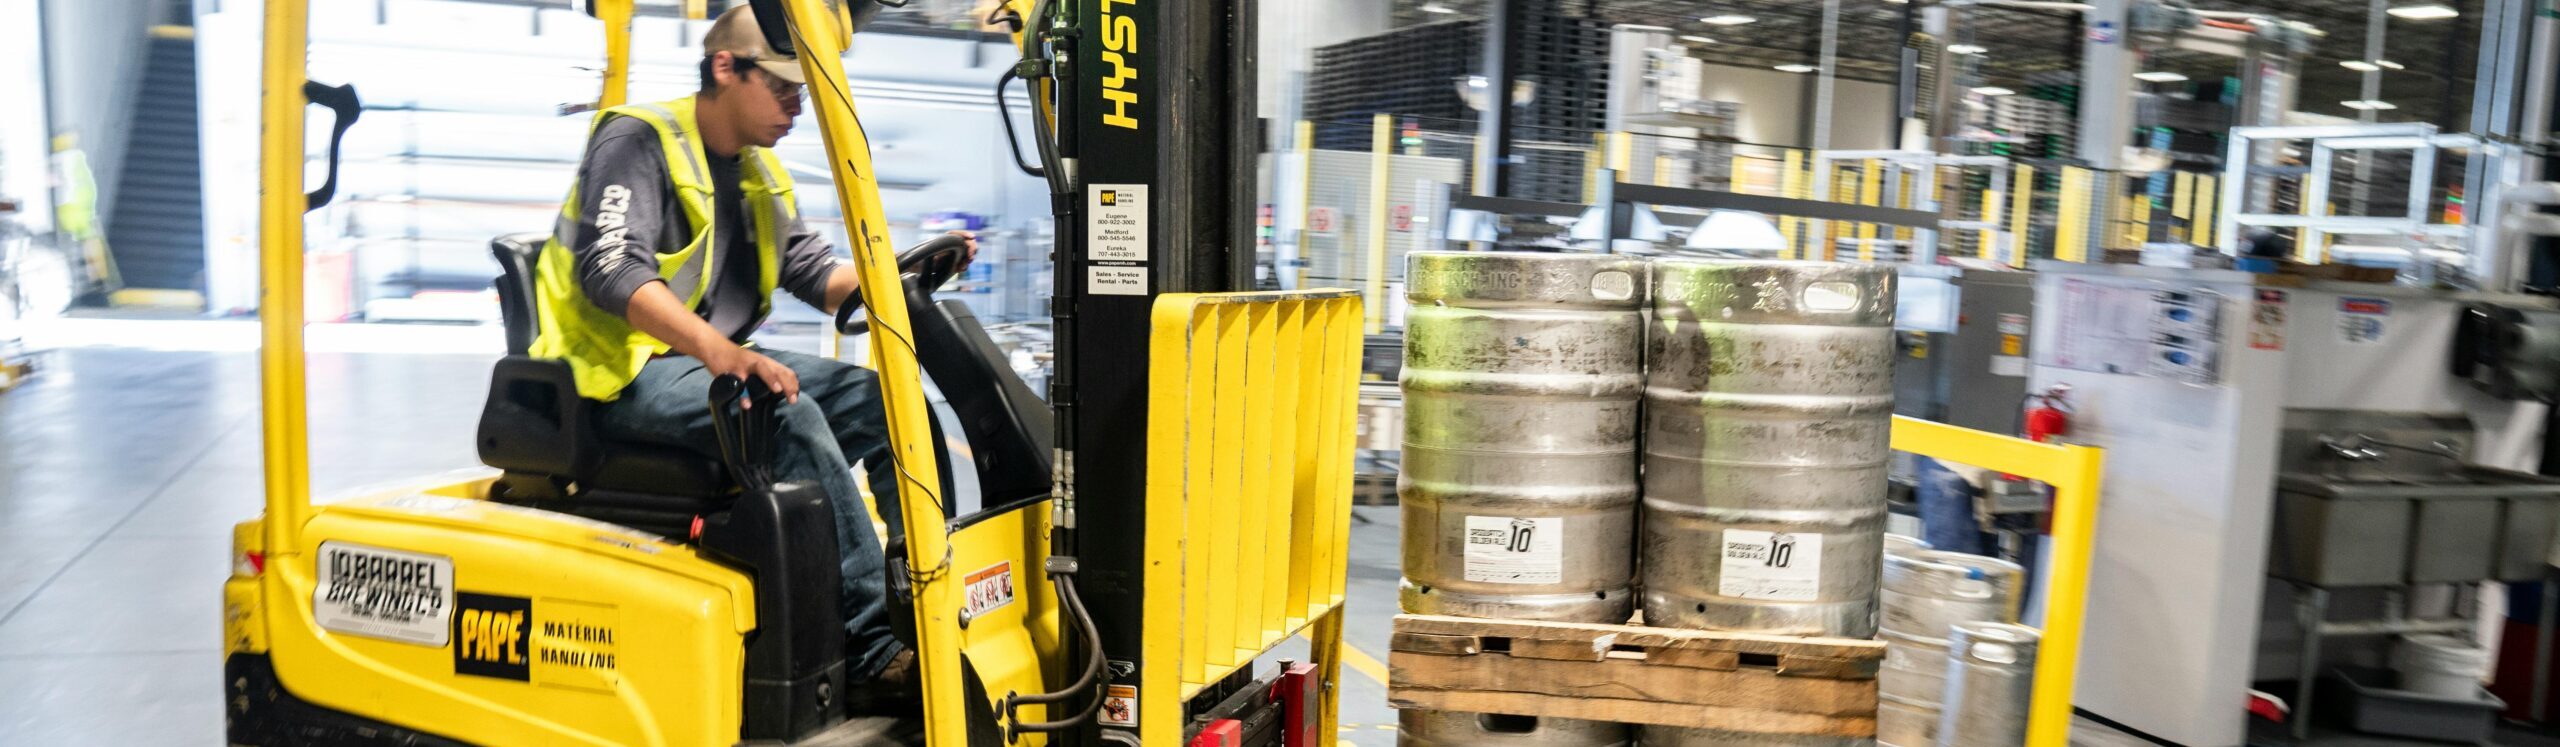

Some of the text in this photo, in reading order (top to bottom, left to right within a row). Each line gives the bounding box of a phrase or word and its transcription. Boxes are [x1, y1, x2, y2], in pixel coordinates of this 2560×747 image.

[1507, 525, 1532, 552] 10
[1766, 540, 1791, 568] 10
[541, 647, 615, 669] HANDLING
